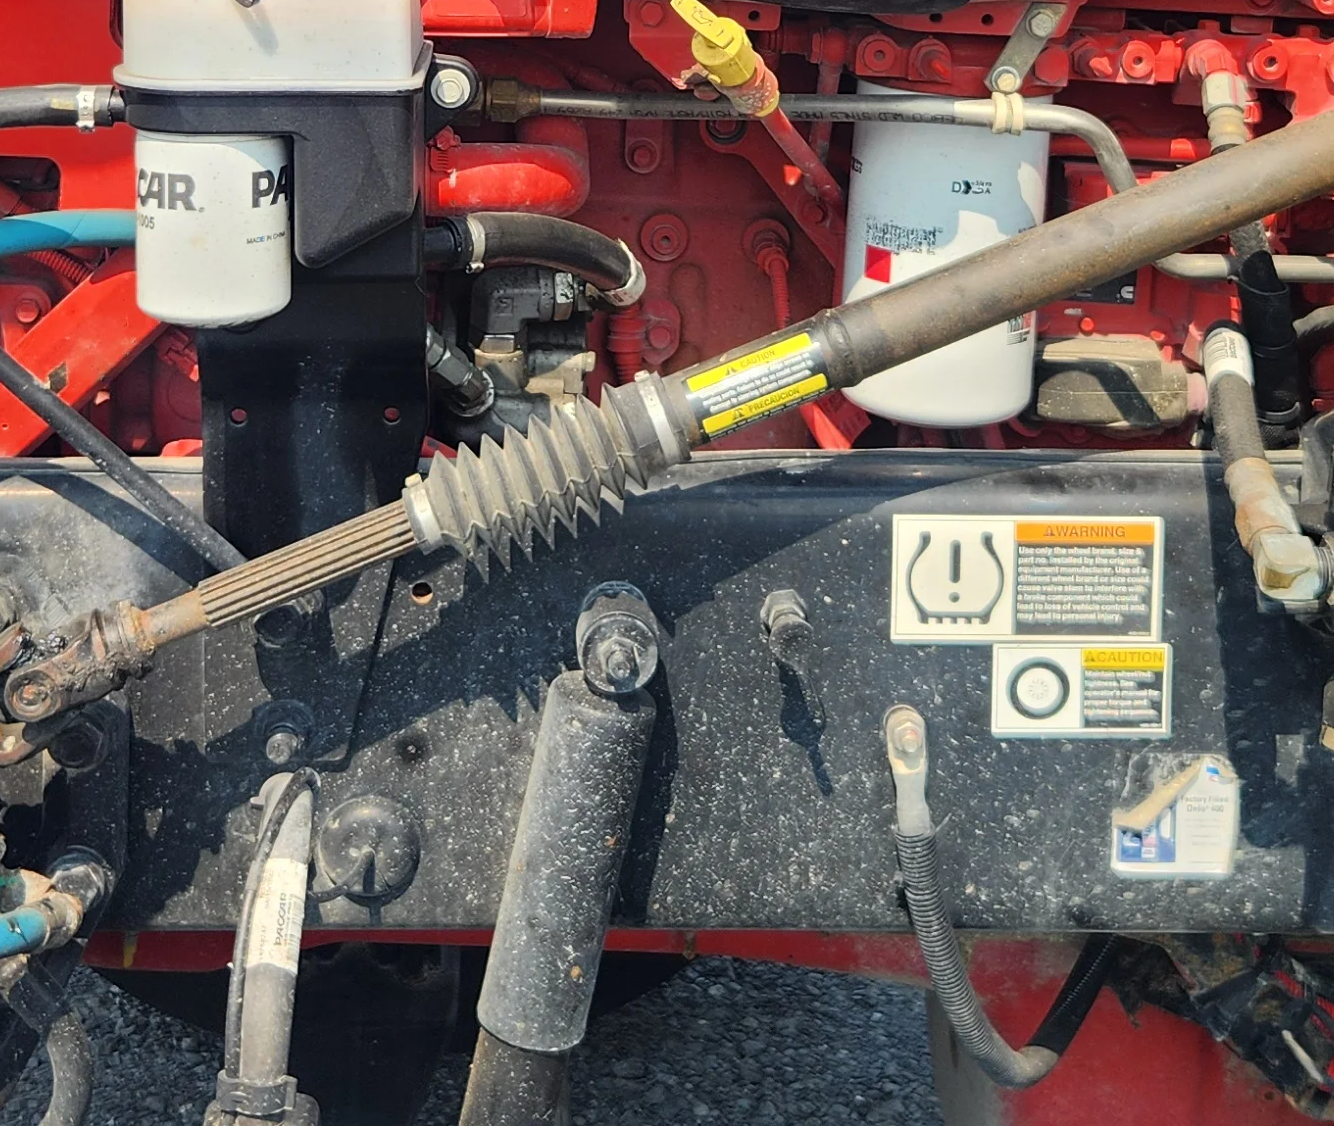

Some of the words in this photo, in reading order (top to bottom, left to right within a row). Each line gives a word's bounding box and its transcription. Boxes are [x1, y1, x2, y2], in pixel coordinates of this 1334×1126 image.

[790, 110, 824, 120] MADE
[246, 235, 265, 244] MADE
[740, 350, 775, 368] CAUTION
[1055, 526, 1126, 537] WARNING
[1097, 651, 1163, 663] CAUTION
